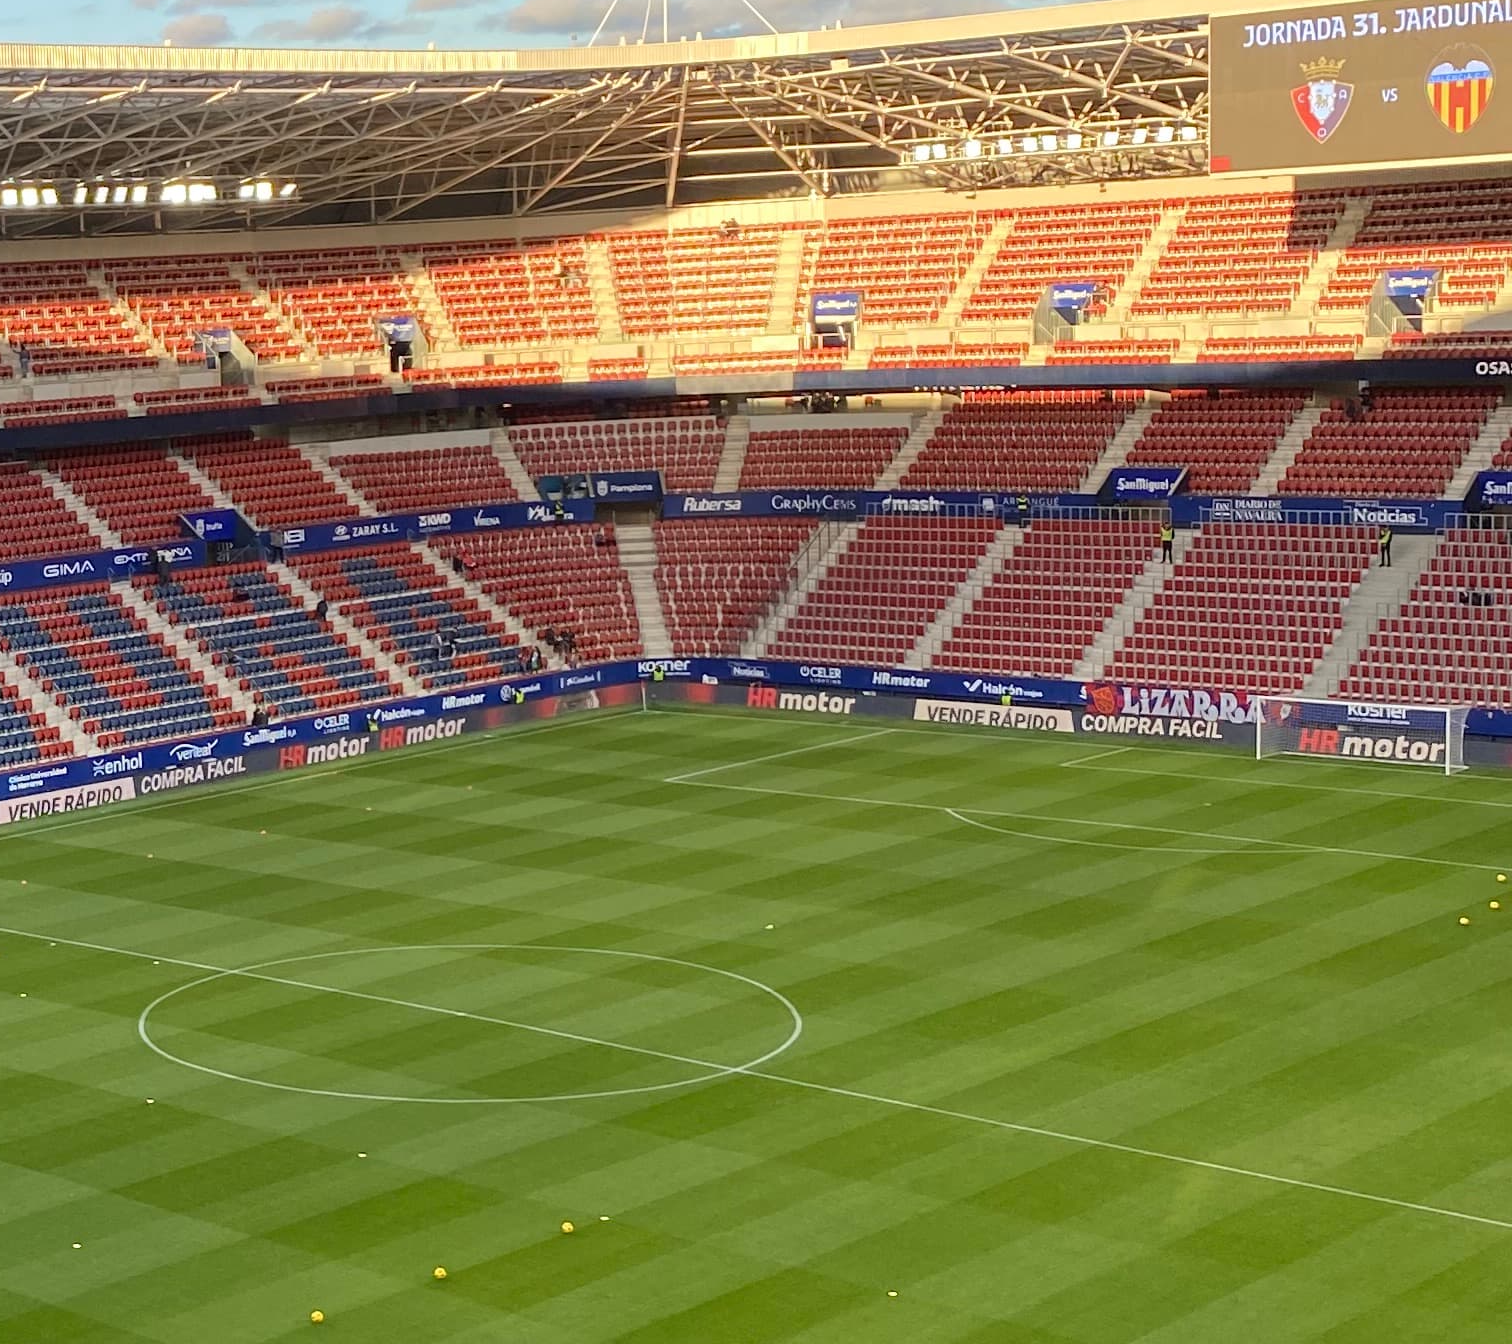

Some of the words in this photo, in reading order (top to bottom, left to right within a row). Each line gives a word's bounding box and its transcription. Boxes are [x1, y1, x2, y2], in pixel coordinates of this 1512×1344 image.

[1243, 15, 1347, 48] JORNADA
[1352, 12, 1387, 36] 31.
[1117, 478, 1169, 493] SanMiguel
[683, 497, 742, 513] Rubersa
[353, 525, 381, 537] ZARAY
[44, 560, 95, 578] GIMA
[811, 667, 841, 679] CELER
[323, 714, 350, 729] CELER
[928, 705, 985, 725] VENDE
[990, 708, 1057, 732] RÁPIDO
[1081, 714, 1165, 735] COMPRA
[141, 765, 205, 794] COMPRA
[8, 797, 61, 822] VENDE
[64, 785, 123, 812] RÁPIDO
